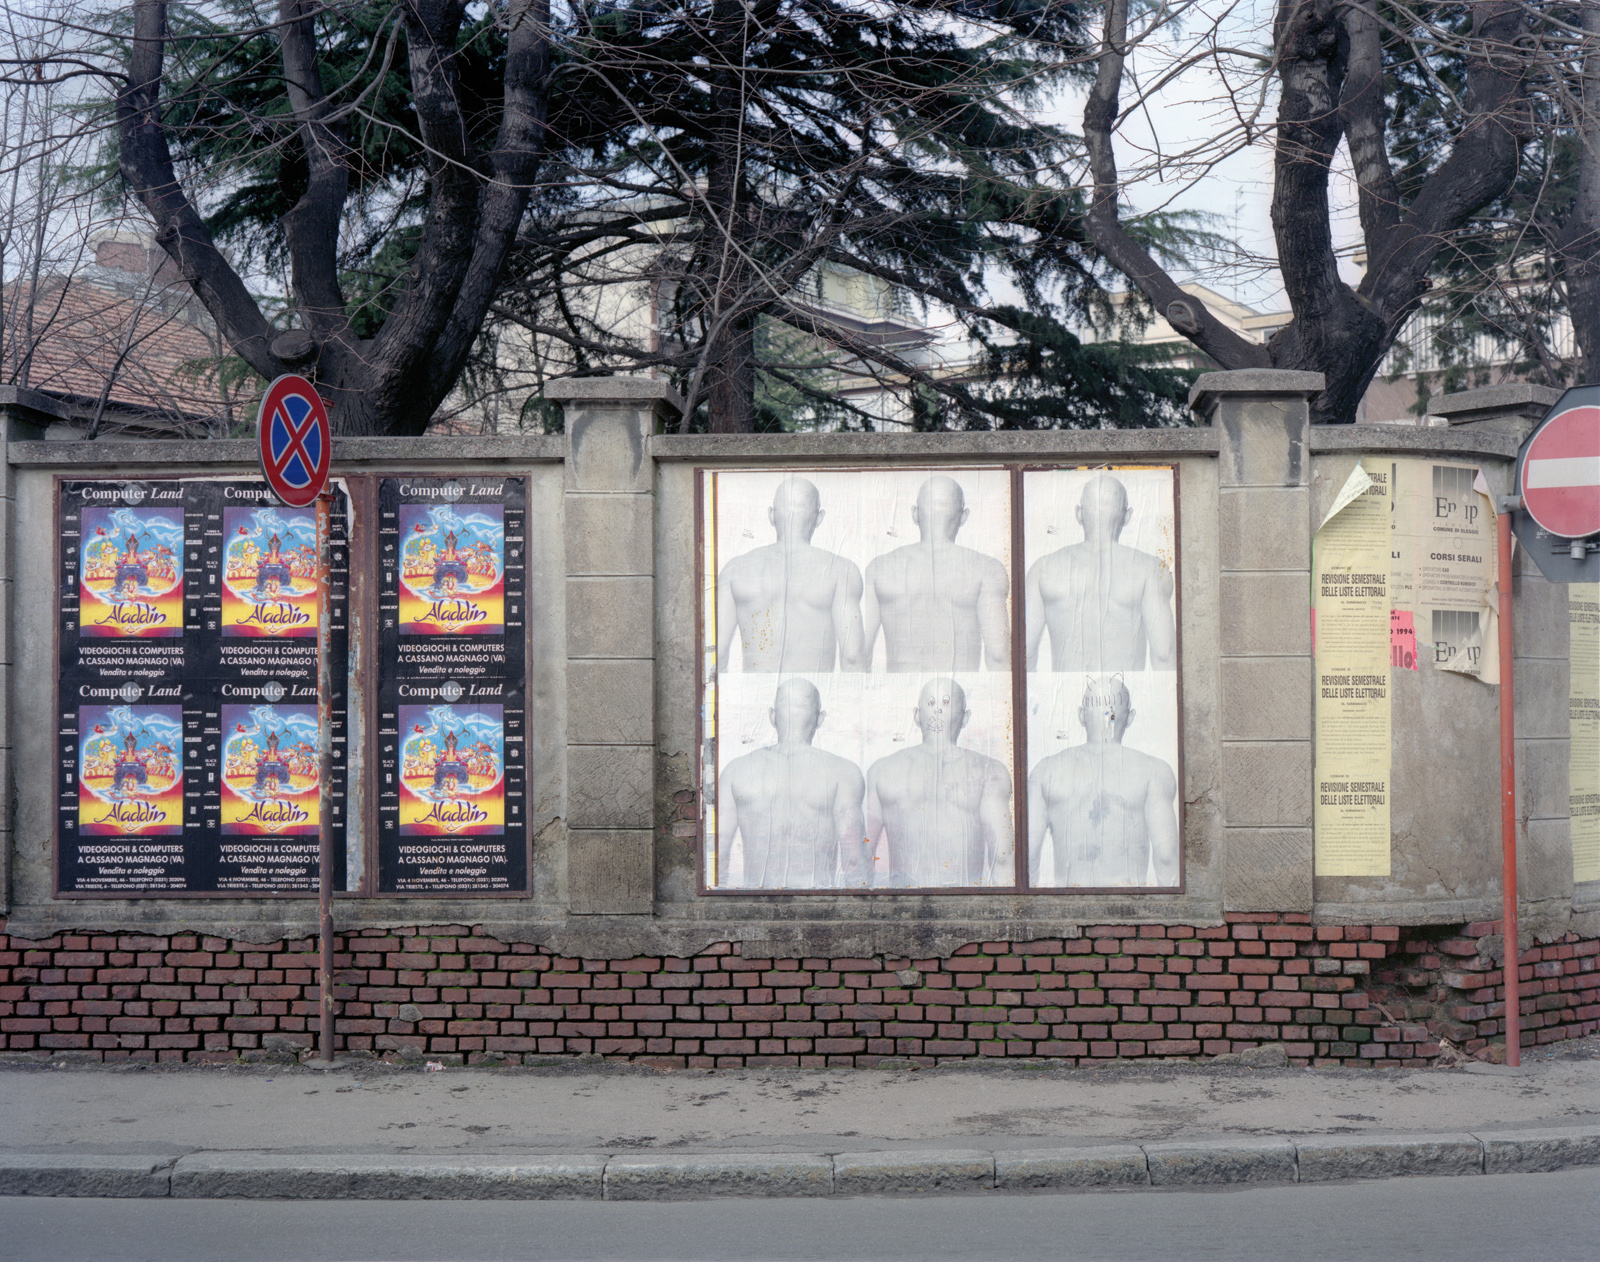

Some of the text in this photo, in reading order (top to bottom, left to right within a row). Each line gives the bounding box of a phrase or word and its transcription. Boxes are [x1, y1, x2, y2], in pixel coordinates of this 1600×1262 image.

[82, 487, 185, 502] Computer Land
[224, 487, 275, 501] Compu
[400, 484, 504, 499] Computer Land
[1430, 552, 1482, 563] CORSI SERALI
[1321, 574, 1386, 584] REVISIONE SEMESTRALE
[1321, 587, 1386, 597] DELLE LISTE ELETTORALI
[94, 602, 167, 625] Aladdin
[236, 602, 310, 625] Aladdin
[413, 600, 488, 622] Aladdin
[79, 647, 184, 655] VIDEOGIOCHI & COMPUTERS
[220, 647, 319, 655] VIDEOGIOCHI & COMPUTE
[78, 657, 185, 666] A CASSANO MAGNAGO (VA)
[220, 657, 311, 665] A CASSANO MAGNAGO
[397, 655, 506, 664] A CASSANO MAGNAGO (VA)
[99, 668, 127, 676] Vendita
[133, 668, 165, 678] noleggio
[240, 668, 268, 676] Vendita
[275, 668, 308, 678] noleggio
[419, 665, 446, 674] Vendita
[454, 665, 486, 675] noleggio
[1321, 675, 1386, 686] REVISIONE SEMESTRALE
[79, 685, 182, 699] Computer Land
[221, 684, 288, 699] Computer
[398, 684, 503, 699] Computer Land
[1321, 688, 1386, 698] DELLE LISTE ELETTORALI
[1320, 782, 1385, 793] REVISIONE SEMESTRALE
[1320, 795, 1385, 805] DELLE LISTE ELETTORALI
[94, 801, 167, 824] Aladdin
[235, 801, 309, 823] Aladdin
[413, 801, 488, 823] Aladdin
[132, 845, 138, 853] &
[138, 845, 184, 853] COMPUTERS
[220, 845, 272, 853] VIDEOGIOCHI
[273, 845, 279, 853] &
[453, 845, 459, 853] &
[460, 845, 506, 853] COMPUTERS
[169, 856, 185, 864] (VA)
[219, 855, 226, 863] A
[227, 855, 266, 863] CASSANO
[267, 855, 310, 863] MAGNAGO
[491, 856, 507, 864] (VA)
[98, 867, 126, 875] Vendita
[133, 867, 165, 876] noleggio
[240, 866, 268, 874] Vendita
[274, 866, 307, 876] noleggio
[419, 867, 447, 875] Vendita
[454, 867, 487, 876] noleggio
